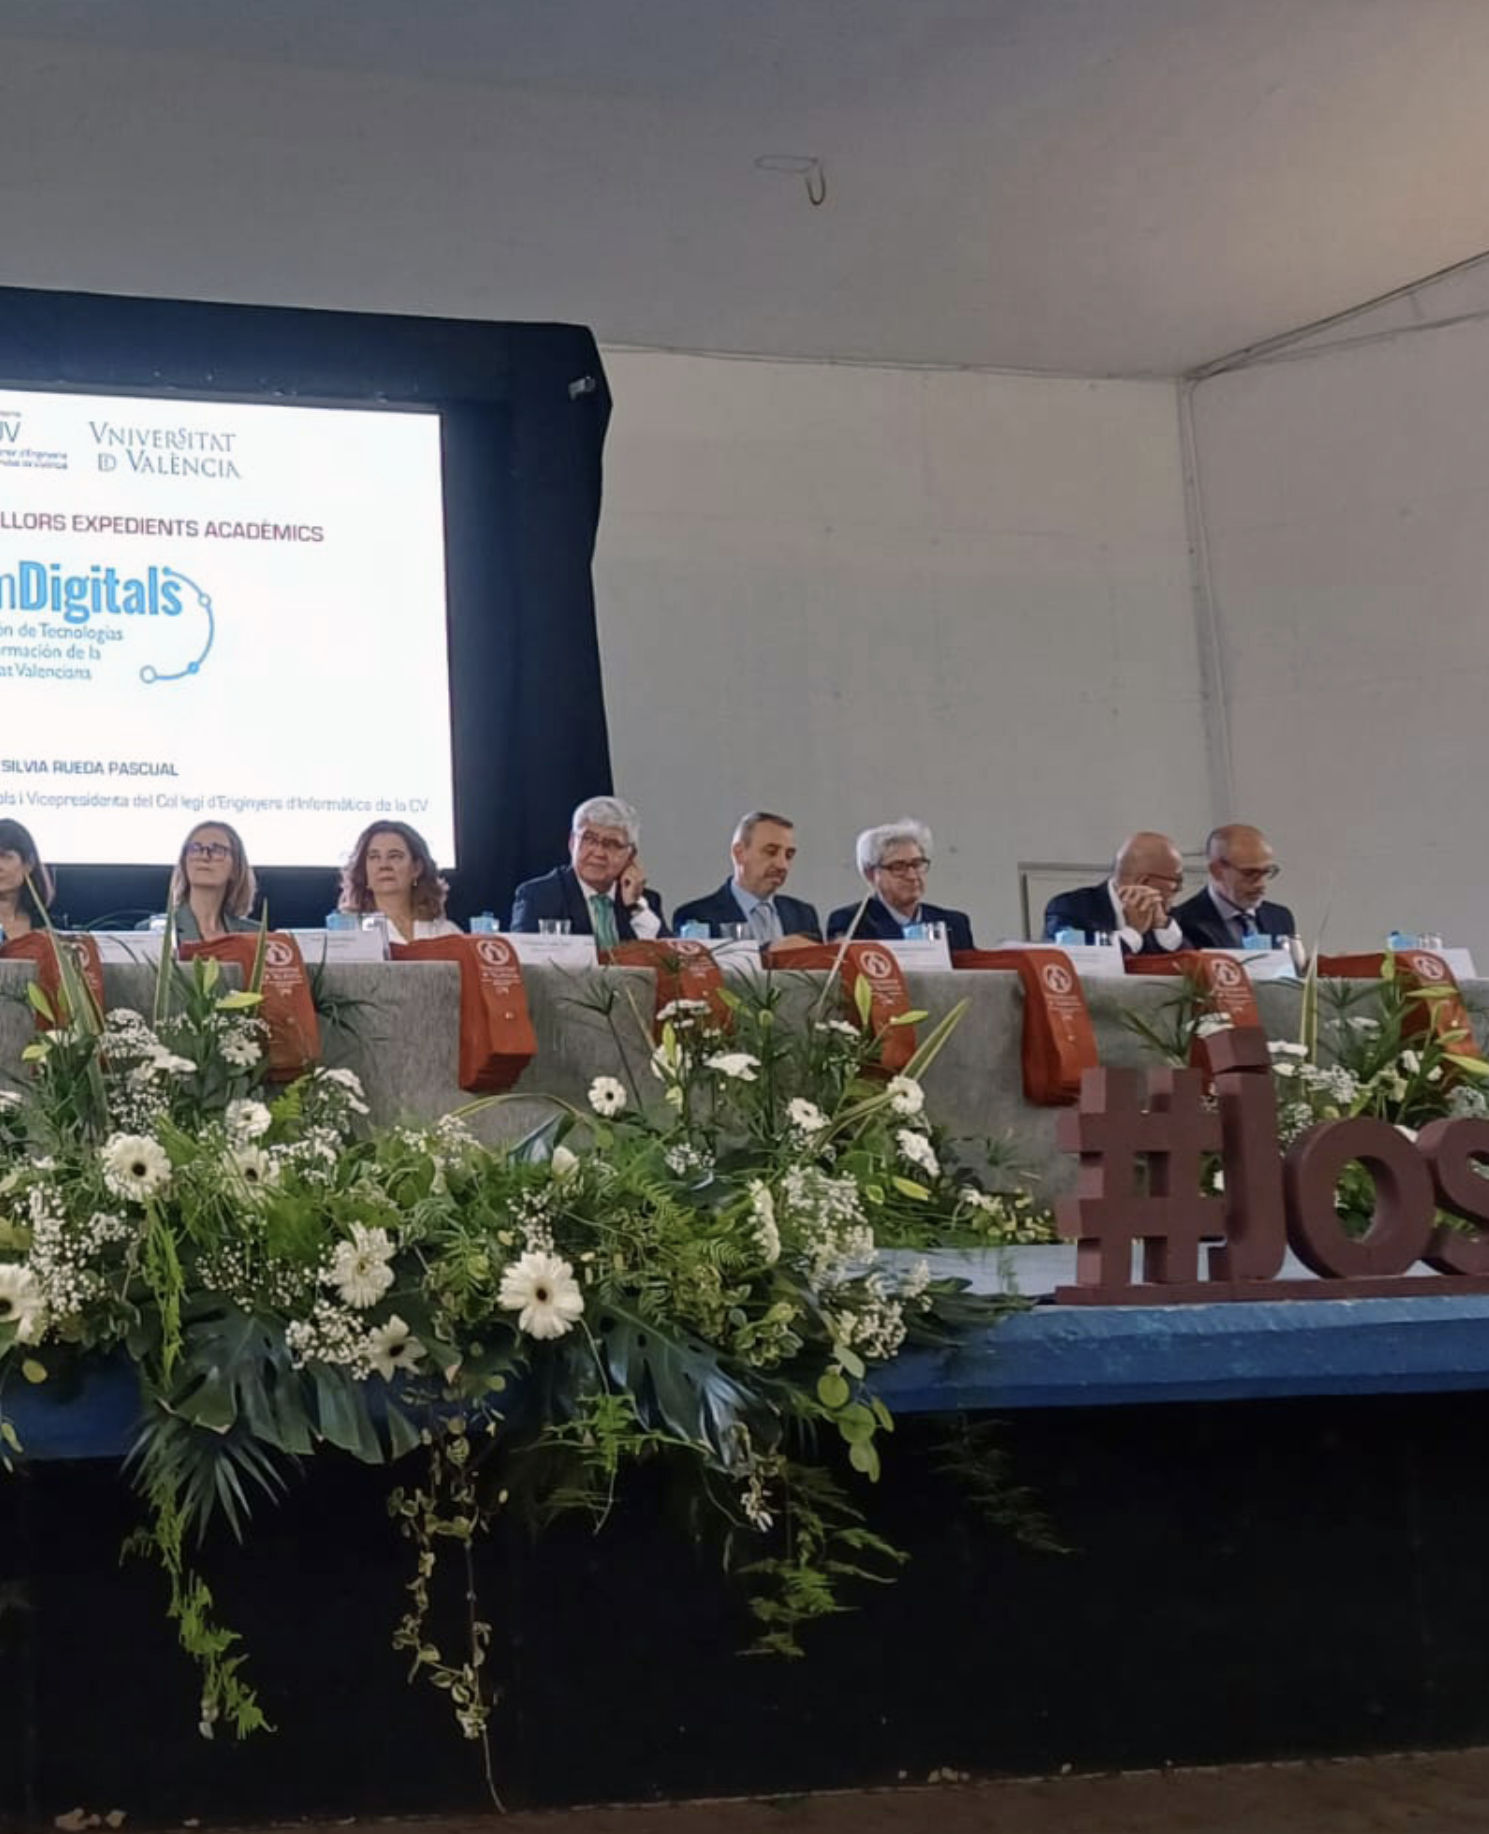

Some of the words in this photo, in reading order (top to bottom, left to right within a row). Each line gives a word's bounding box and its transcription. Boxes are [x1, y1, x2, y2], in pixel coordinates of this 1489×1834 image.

[72, 513, 200, 538] EXPEDIENTS
[18, 622, 36, 638] de
[66, 644, 85, 660] de
[89, 645, 101, 660] la
[14, 662, 92, 680] Valenciana
[1, 759, 49, 774] SILVIA
[53, 760, 104, 775] RUEDA
[108, 761, 179, 776] PASCUAL
[26, 791, 130, 809] Vicepresidenta
[133, 794, 153, 808] del
[376, 797, 392, 812] de
